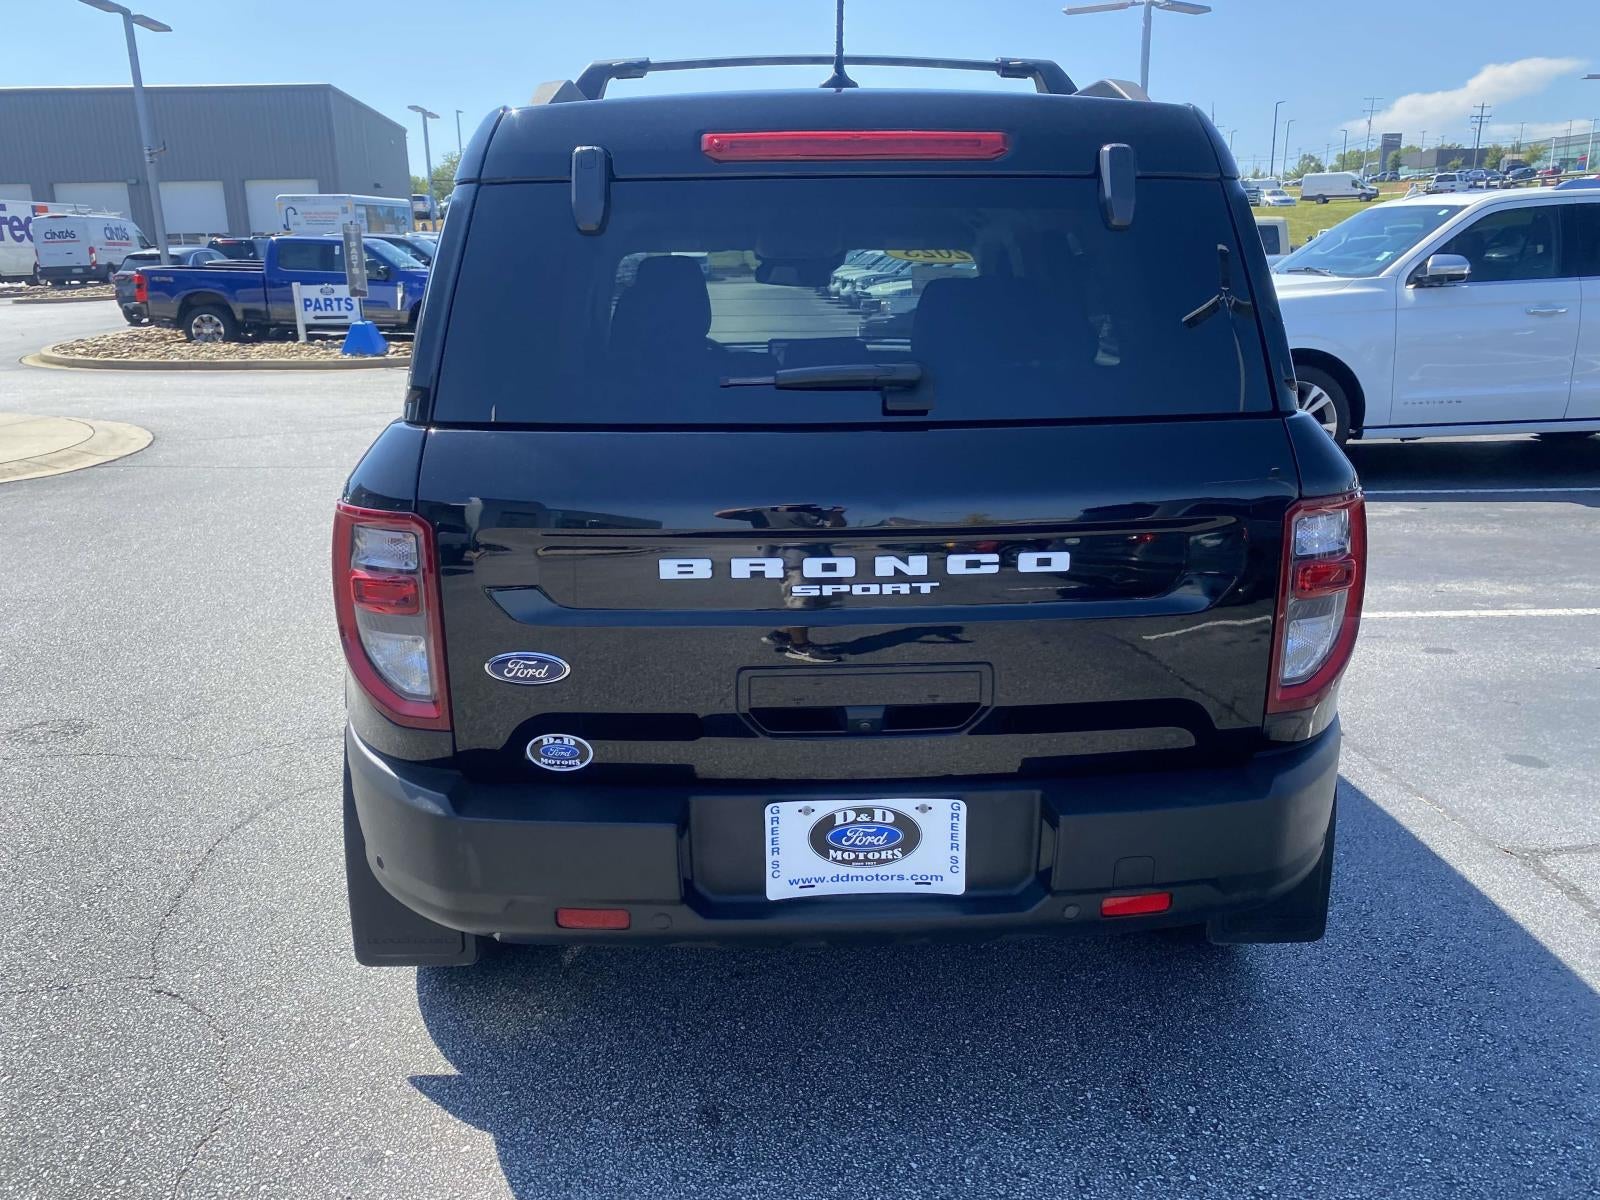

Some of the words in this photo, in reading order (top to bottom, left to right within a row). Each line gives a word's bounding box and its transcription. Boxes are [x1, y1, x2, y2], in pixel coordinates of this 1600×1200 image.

[44, 229, 76, 240] CINTAS
[303, 297, 354, 312] PARTS
[658, 551, 1071, 580] BRONCO
[791, 582, 940, 597] SPORT
[503, 659, 549, 678] Ford
[542, 737, 576, 746] D&D
[547, 747, 572, 757] Ford
[540, 757, 580, 766] MOTORS
[834, 808, 895, 827] D&D
[770, 805, 780, 856] GREER
[950, 802, 961, 852] GREER
[841, 827, 887, 846] Ford
[828, 847, 903, 861] MOTORS
[771, 860, 781, 879] SC
[949, 855, 960, 874] SC
[788, 872, 944, 886] www.ddmotors.com
